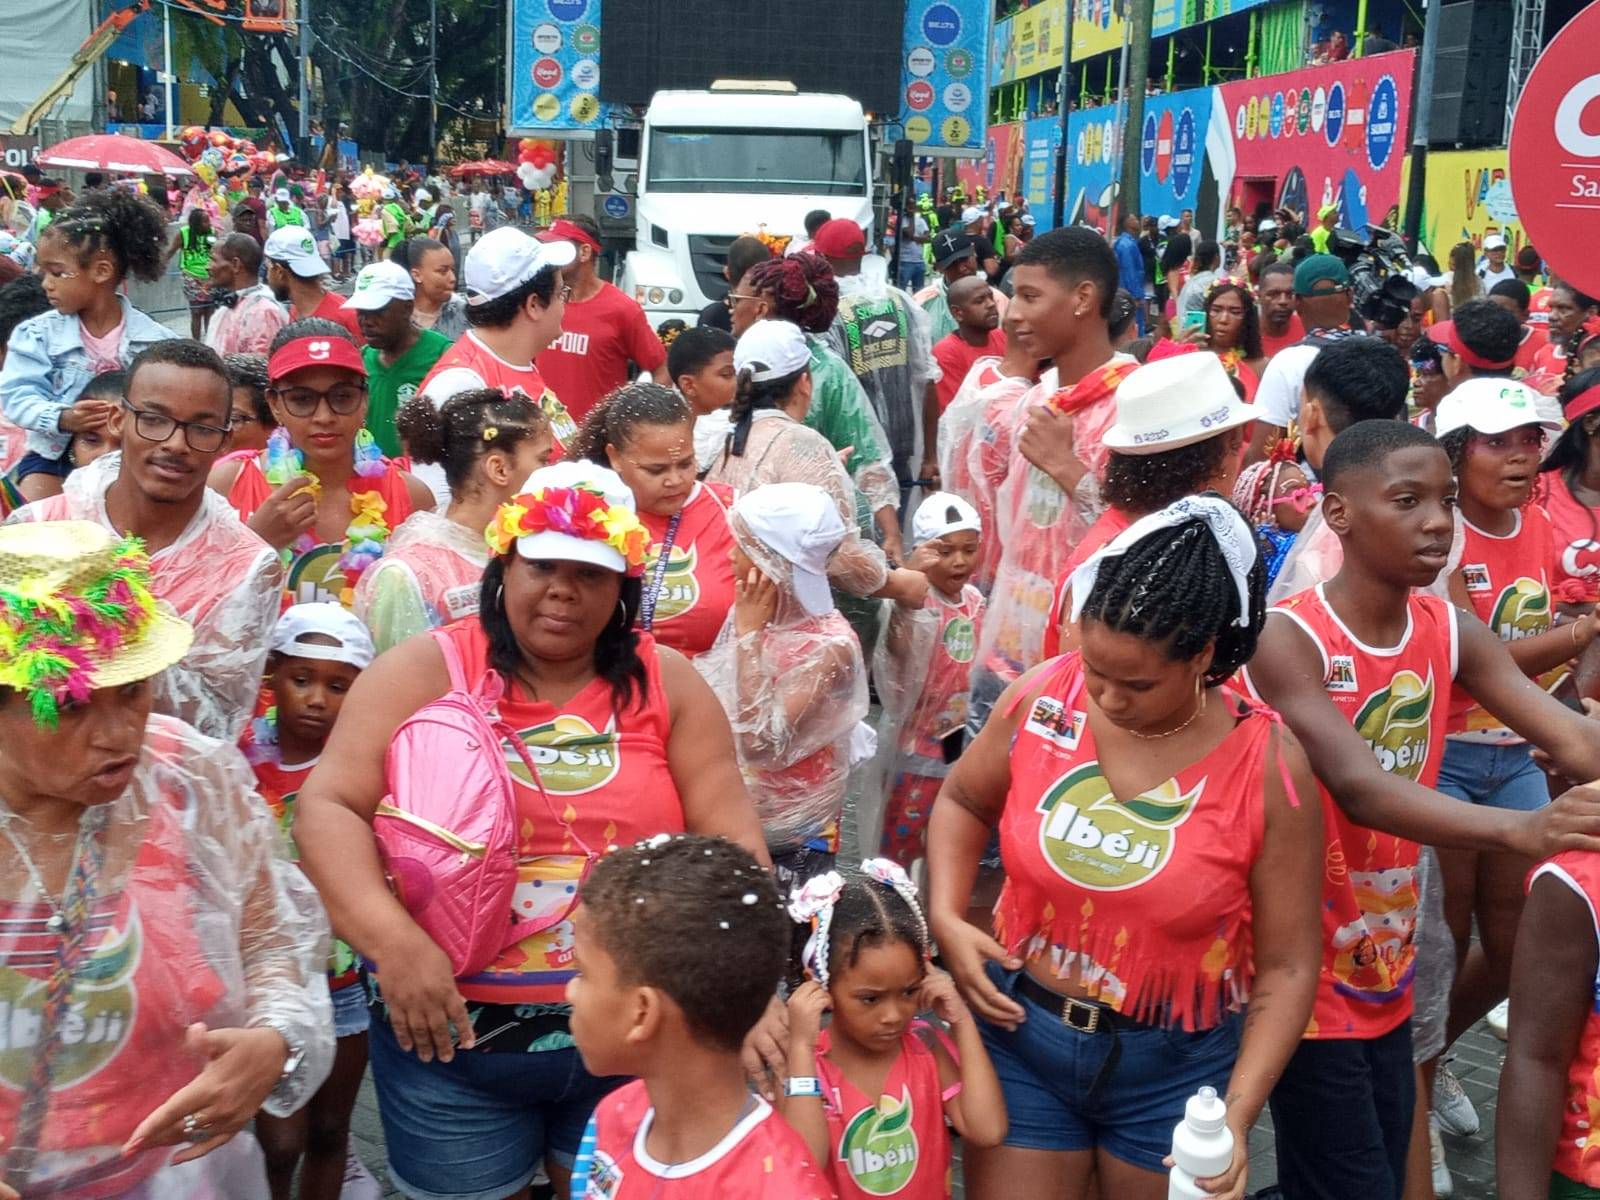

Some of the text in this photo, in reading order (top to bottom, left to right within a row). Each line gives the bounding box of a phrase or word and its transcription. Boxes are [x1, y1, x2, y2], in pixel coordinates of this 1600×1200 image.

[547, 331, 589, 355] POIO
[1365, 736, 1425, 772] béji
[1046, 801, 1162, 869] Ibéji
[852, 1143, 915, 1175] Ibéji
